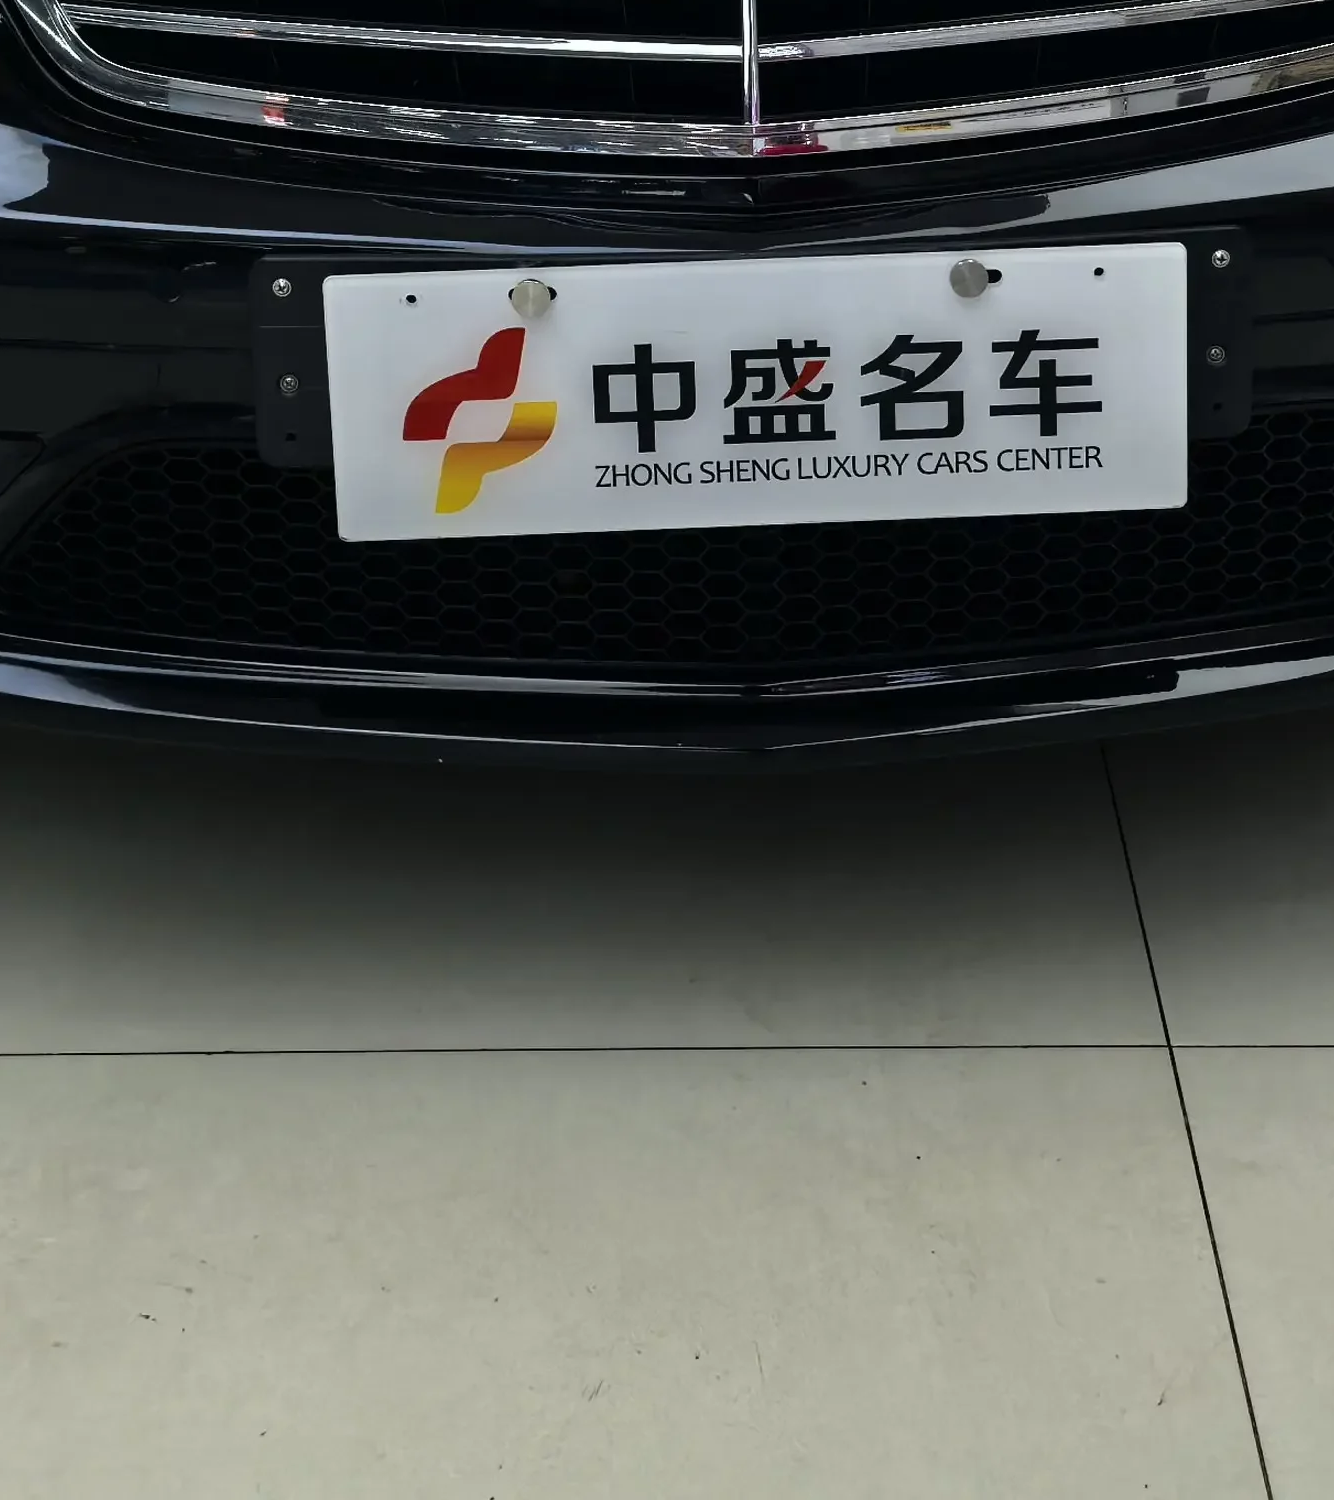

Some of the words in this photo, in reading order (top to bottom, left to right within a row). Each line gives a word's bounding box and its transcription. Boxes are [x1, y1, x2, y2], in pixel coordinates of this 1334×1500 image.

[592, 329, 1103, 454] 中盛名车
[594, 461, 693, 488] ZHONG
[699, 457, 791, 484] SHENG
[797, 453, 909, 480] LUXURY
[916, 450, 989, 475] CARS
[996, 445, 1104, 472] CENTER
